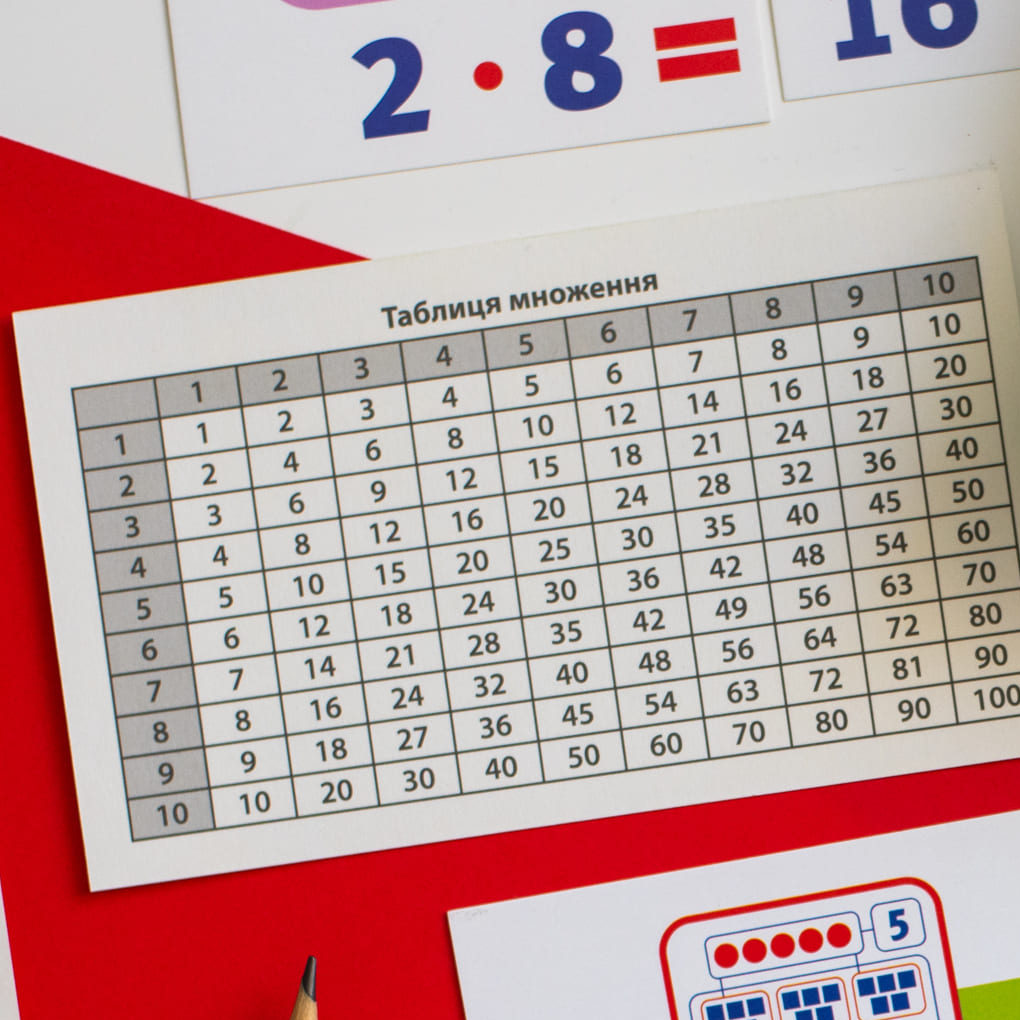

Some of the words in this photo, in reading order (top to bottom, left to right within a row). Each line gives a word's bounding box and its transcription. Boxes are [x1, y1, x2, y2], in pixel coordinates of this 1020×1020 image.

[350, 36, 431, 141] 2
[540, 9, 624, 112] 8
[190, 380, 203, 404] 1
[271, 368, 289, 393] 2
[353, 356, 370, 380] 3
[435, 344, 453, 367] 4
[519, 332, 534, 357] 5
[600, 320, 618, 344] 6
[681, 308, 698, 333] 7
[765, 296, 782, 320] 8
[847, 284, 864, 309] 9
[922, 271, 955, 297] 10
[381, 295, 502, 329] Таблиця
[509, 273, 659, 311] множення
[114, 433, 126, 456] 1
[196, 422, 208, 445] 1
[277, 410, 294, 433] 2
[359, 398, 376, 421] 3
[441, 386, 459, 408] 4
[525, 374, 540, 397] 5
[606, 361, 623, 385] 6
[687, 349, 703, 374] 7
[771, 338, 788, 361] 8
[853, 326, 870, 350] 9
[928, 312, 961, 338] 10
[119, 474, 136, 498] 2
[201, 462, 218, 486] 2
[282, 450, 300, 473] 4
[365, 438, 382, 462] 6
[447, 427, 464, 450] 8
[522, 414, 554, 439] 10
[604, 402, 637, 427] 12
[687, 390, 720, 415] 14
[769, 377, 802, 403] 16
[852, 366, 885, 391] 18
[933, 353, 967, 380] 20
[124, 515, 141, 539] 3
[206, 503, 223, 527] 3
[288, 491, 305, 515] 6
[370, 480, 387, 504] 9
[445, 467, 478, 492] 12
[527, 455, 560, 480] 15
[610, 443, 643, 468] 18
[691, 431, 721, 457] 21
[774, 419, 808, 445] 24
[856, 407, 889, 433] 27
[939, 395, 973, 421] 30
[136, 597, 152, 621] 5
[219, 585, 234, 609] 5
[292, 572, 325, 598] 10
[374, 560, 406, 586] 15
[455, 549, 489, 575] 20
[538, 537, 571, 563] 25
[621, 525, 654, 551] 30
[703, 513, 736, 539] 35
[786, 502, 819, 527] 40
[868, 489, 902, 515] 45
[952, 478, 985, 504] 50
[146, 679, 162, 703] 7
[228, 667, 244, 692] 7
[304, 655, 337, 680] 14
[385, 643, 415, 669] 21
[467, 631, 501, 658] 28
[549, 619, 583, 645] 35
[632, 608, 666, 633] 42
[715, 596, 748, 621] 49
[798, 584, 831, 610] 56
[880, 572, 913, 598] 63
[962, 560, 997, 587] 70
[156, 802, 189, 827] 10
[239, 790, 271, 815] 10
[320, 778, 353, 805] 20
[402, 767, 436, 793] 30
[484, 755, 518, 780] 40
[568, 743, 601, 769] 50
[649, 732, 683, 757] 60
[732, 720, 766, 746] 70
[815, 708, 849, 734] 80
[897, 696, 932, 723] 90
[157, 762, 175, 786] 9
[240, 750, 257, 774] 9
[315, 737, 348, 763] 18
[396, 725, 428, 752] 27
[479, 713, 513, 740] 36
[561, 702, 594, 727] 45
[645, 690, 678, 716] 54
[726, 679, 760, 704] 63
[887, 907, 910, 942] 5
